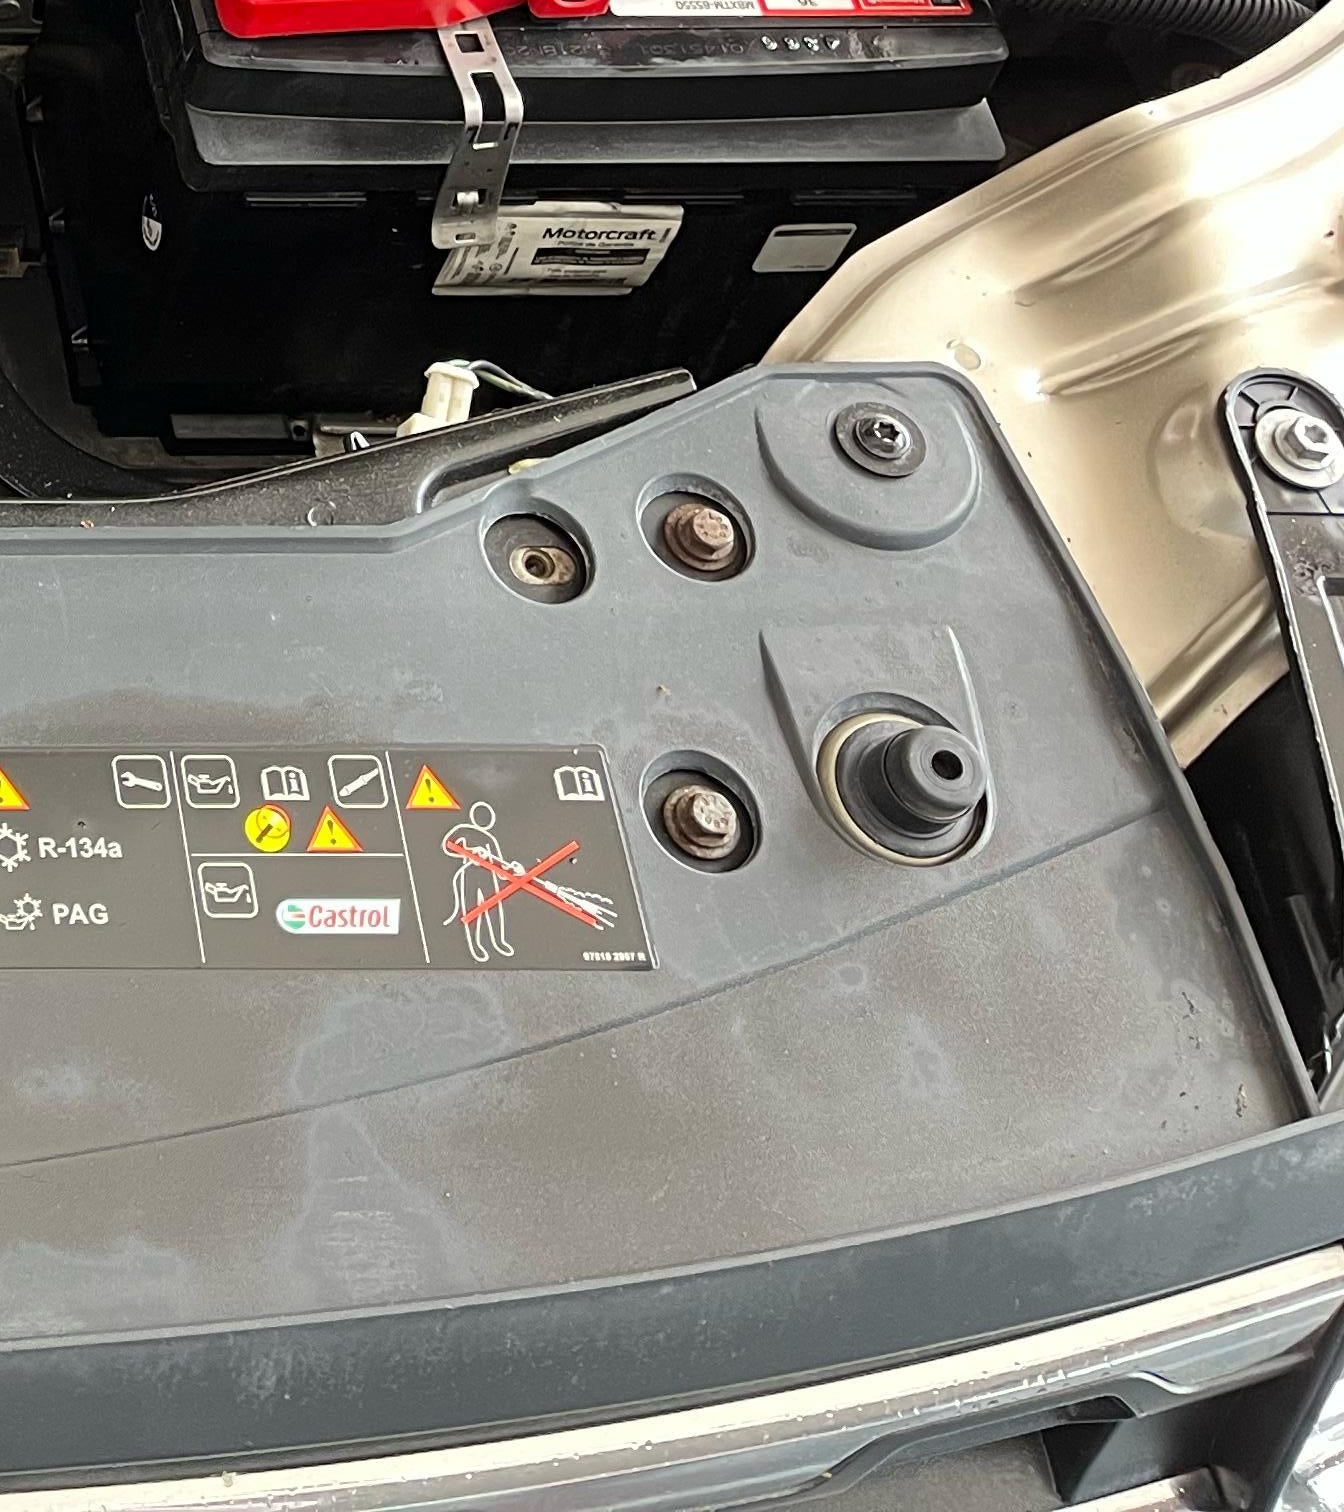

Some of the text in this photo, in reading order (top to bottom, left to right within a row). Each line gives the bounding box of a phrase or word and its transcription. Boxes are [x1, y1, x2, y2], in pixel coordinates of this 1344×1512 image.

[542, 227, 657, 241] Motorcraft
[37, 837, 124, 859] R-134a
[52, 903, 110, 925] PAG
[308, 904, 391, 928] Castrol
